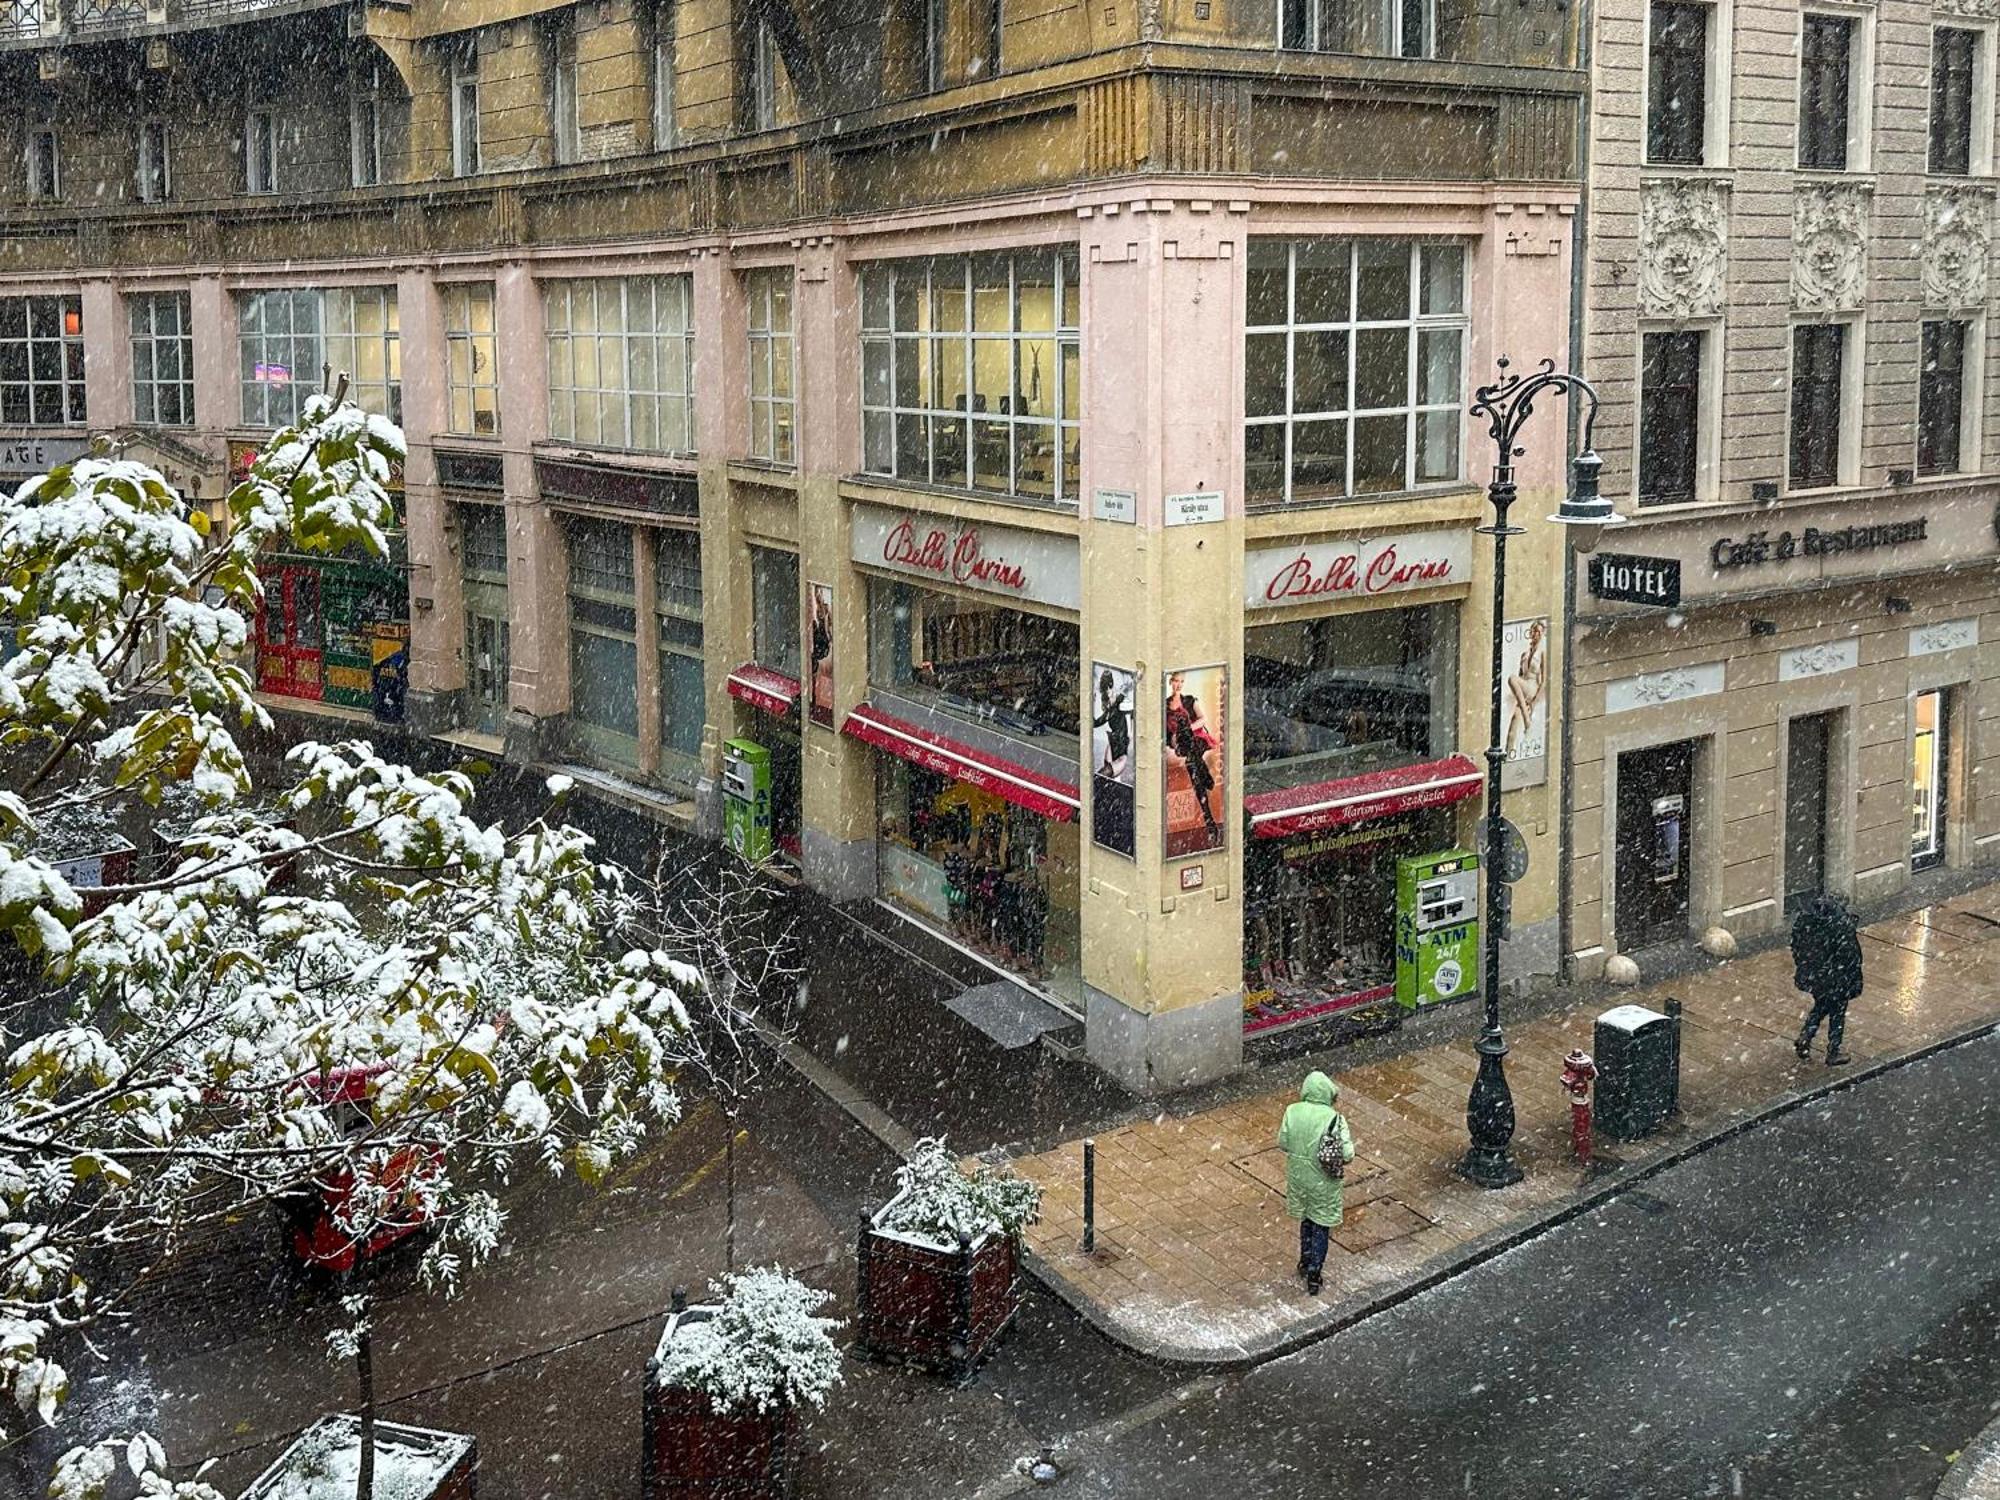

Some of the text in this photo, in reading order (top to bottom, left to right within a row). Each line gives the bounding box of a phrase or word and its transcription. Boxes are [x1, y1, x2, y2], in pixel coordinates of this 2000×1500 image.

[884, 515, 1025, 588] Bella Carina
[1711, 516, 1928, 570] Café & Restaurant
[1266, 544, 1452, 600] Bella Carina
[1603, 561, 1667, 597] HOTEL
[1401, 789, 1446, 808] Szaküzlet
[1438, 863, 1457, 875] ATM
[1398, 913, 1415, 965] ATM
[1431, 927, 1467, 947] ATM
[1436, 944, 1461, 960] 24/7
